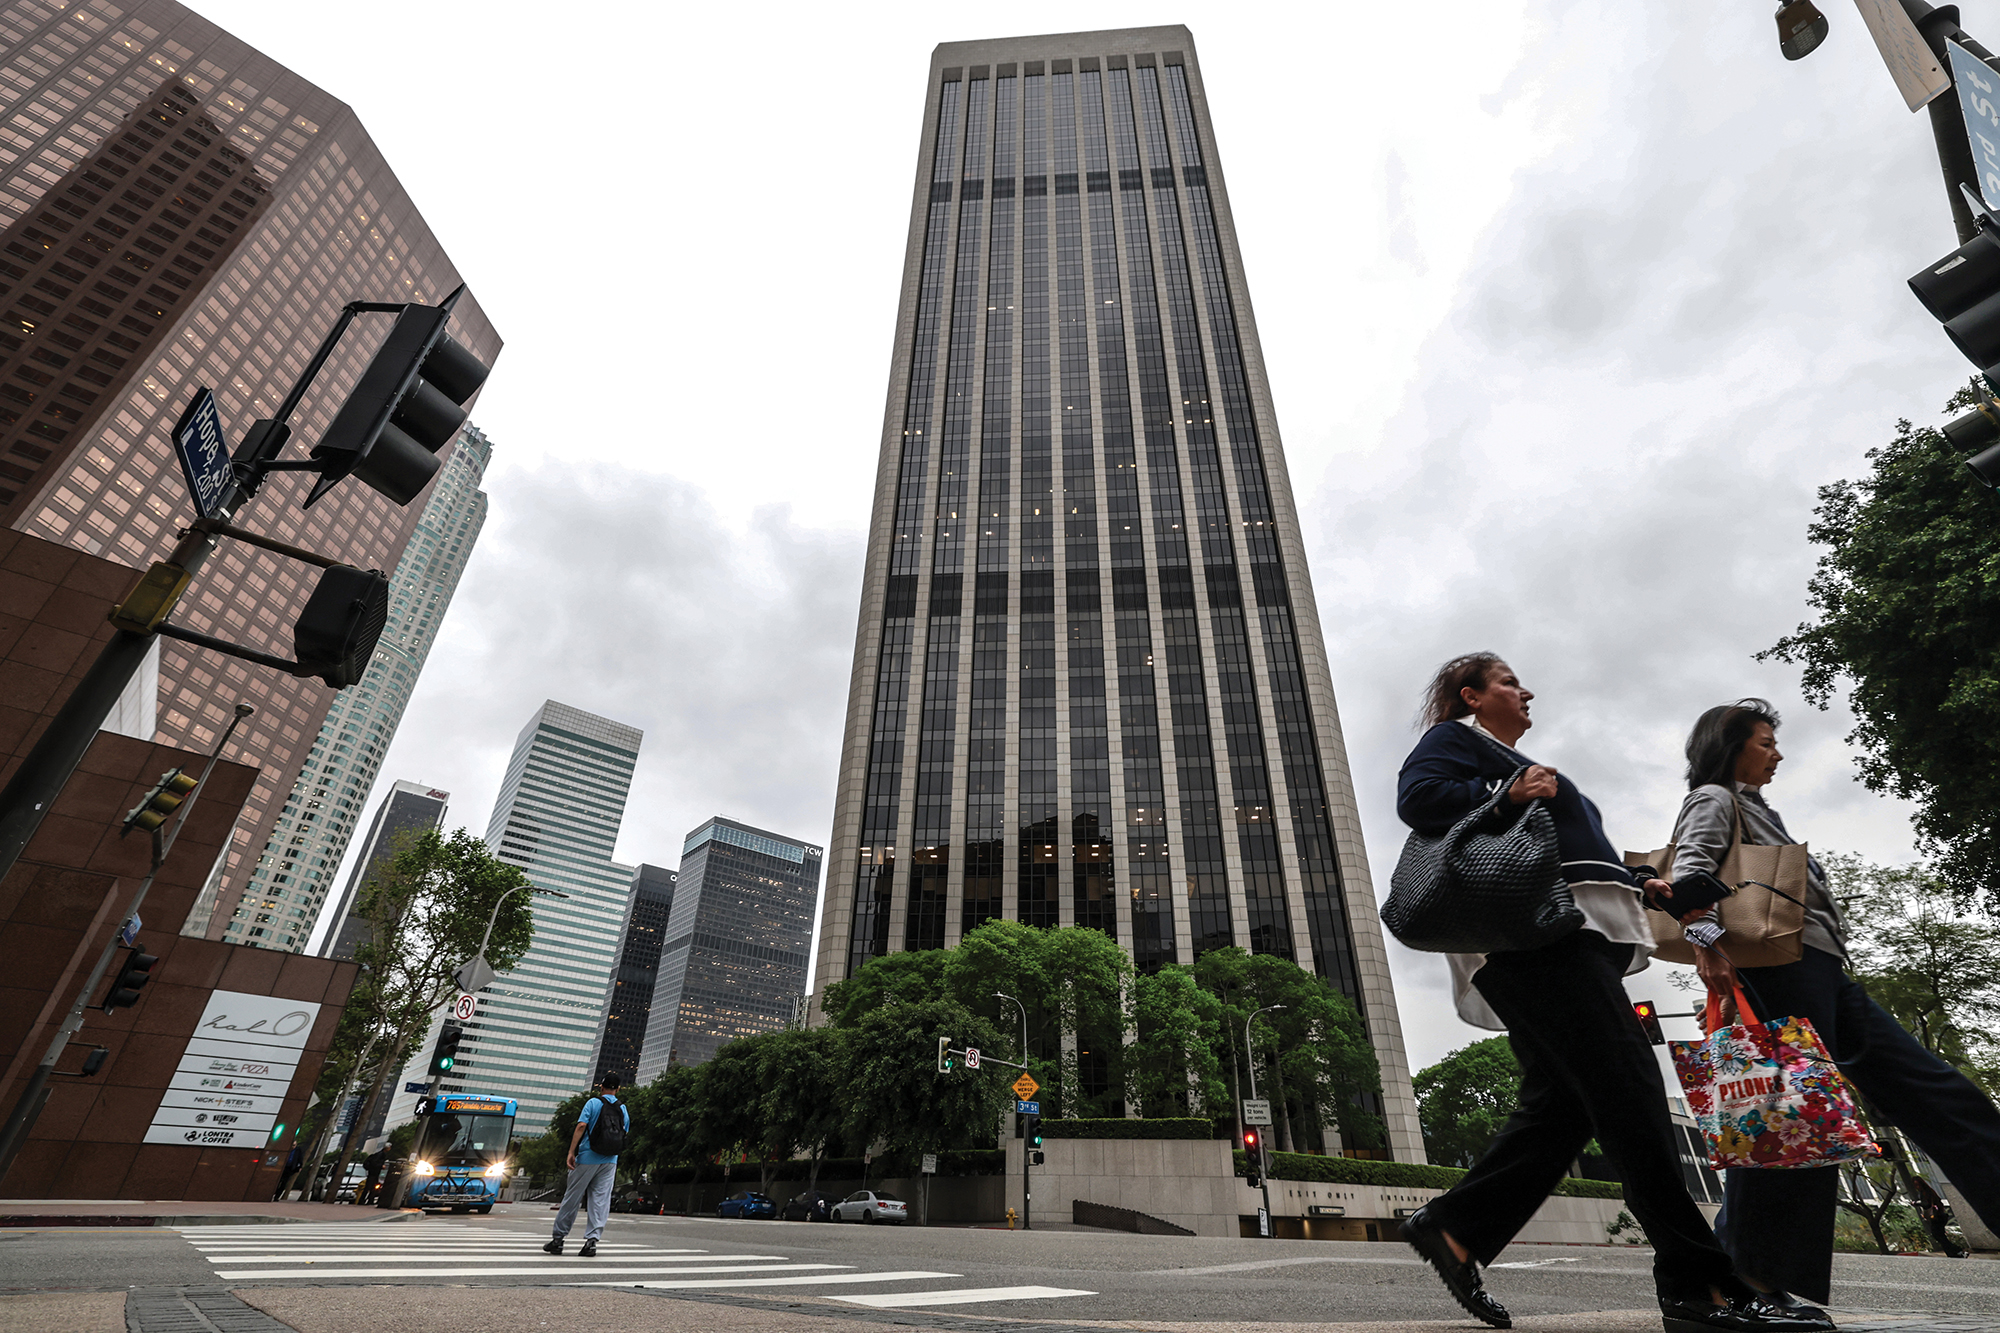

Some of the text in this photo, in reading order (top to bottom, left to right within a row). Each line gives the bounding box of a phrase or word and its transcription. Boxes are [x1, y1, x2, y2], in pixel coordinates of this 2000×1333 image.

[1902, 26, 1925, 82] AHEAD
[1965, 70, 1999, 127] St
[195, 400, 232, 496] Hope St
[197, 467, 217, 511] 200 S
[426, 789, 447, 800] AON
[804, 846, 823, 857] TCW
[240, 1063, 269, 1075] PIZZA
[1718, 1075, 1786, 1102] PYLONES
[446, 1100, 461, 1110] 785
[1289, 1190, 1316, 1198] EXIT
